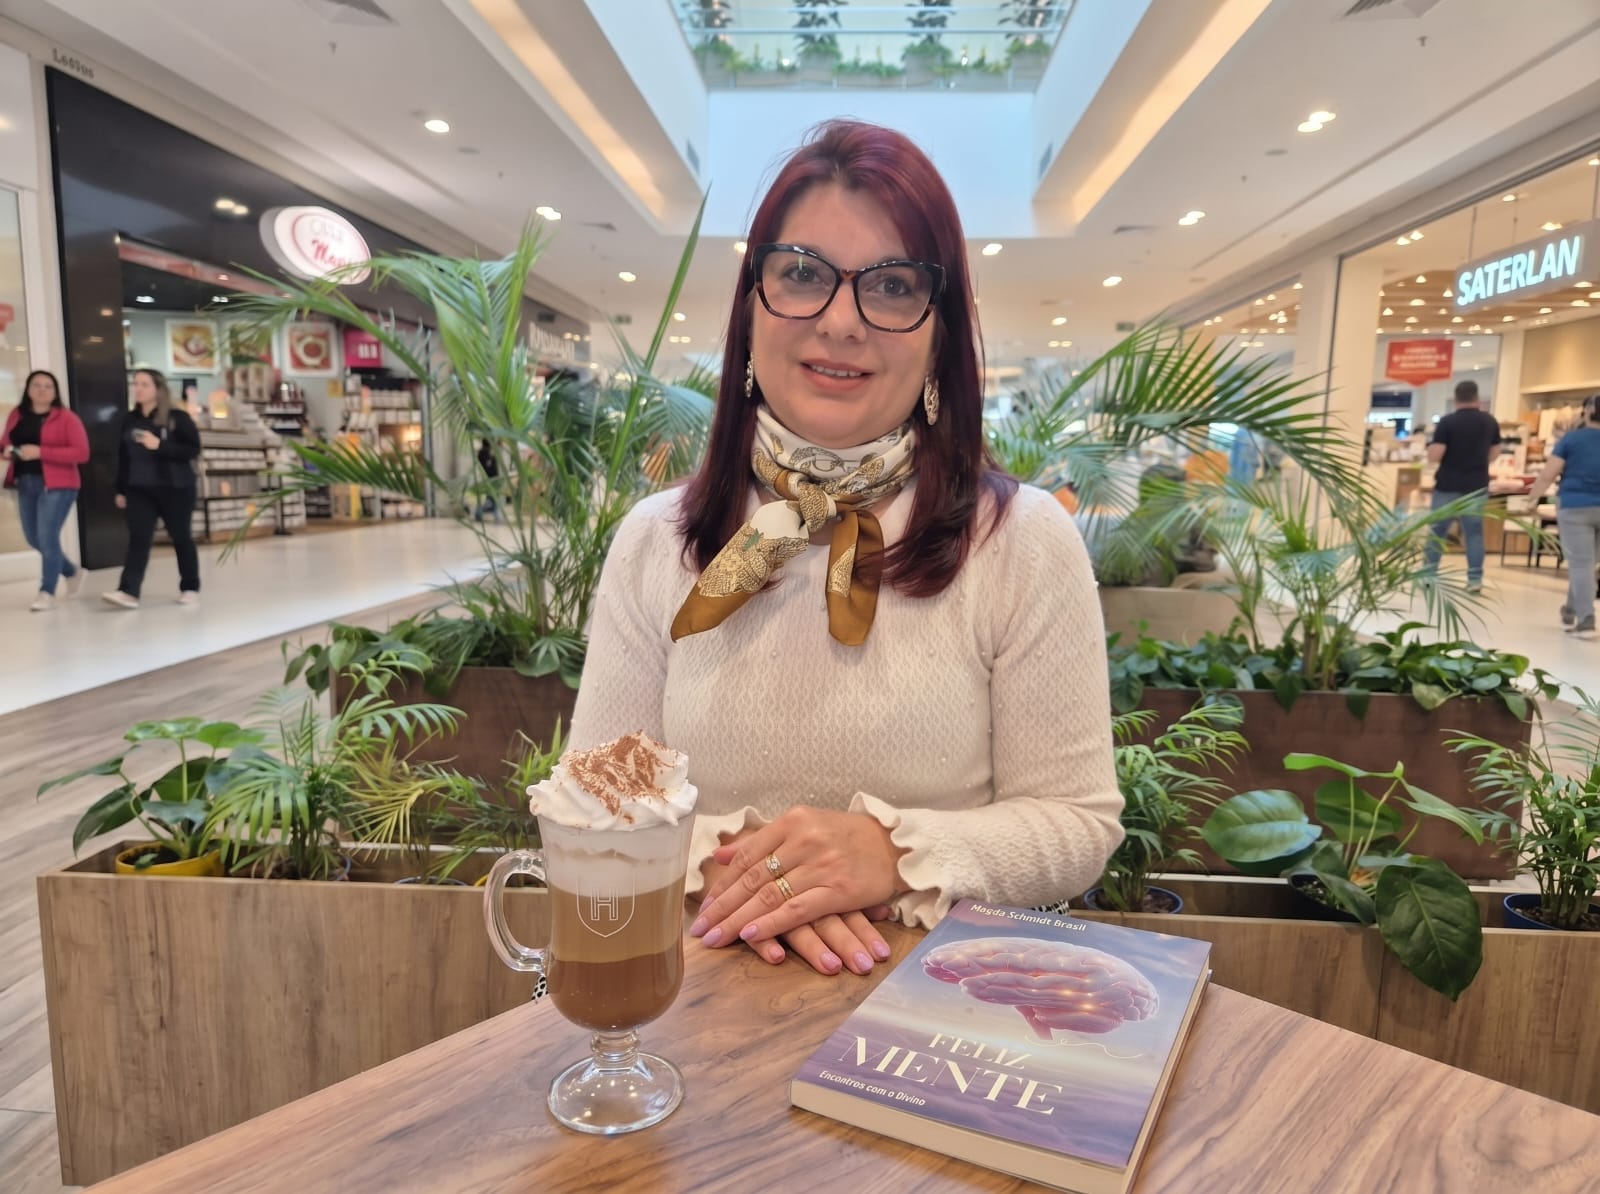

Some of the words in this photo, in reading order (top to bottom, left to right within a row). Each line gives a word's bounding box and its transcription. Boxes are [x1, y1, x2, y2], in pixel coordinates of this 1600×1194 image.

[1457, 235, 1581, 306] SATERLAN
[970, 904, 1006, 917] Magda
[1007, 911, 1052, 926] Schmidt
[1054, 920, 1087, 932] Brasil
[928, 1032, 1033, 1070] FELIZ
[819, 1070, 866, 1090] Encontros
[866, 1084, 887, 1097] com
[895, 1091, 927, 1106] Divino
[837, 1035, 1064, 1115] MENTE
